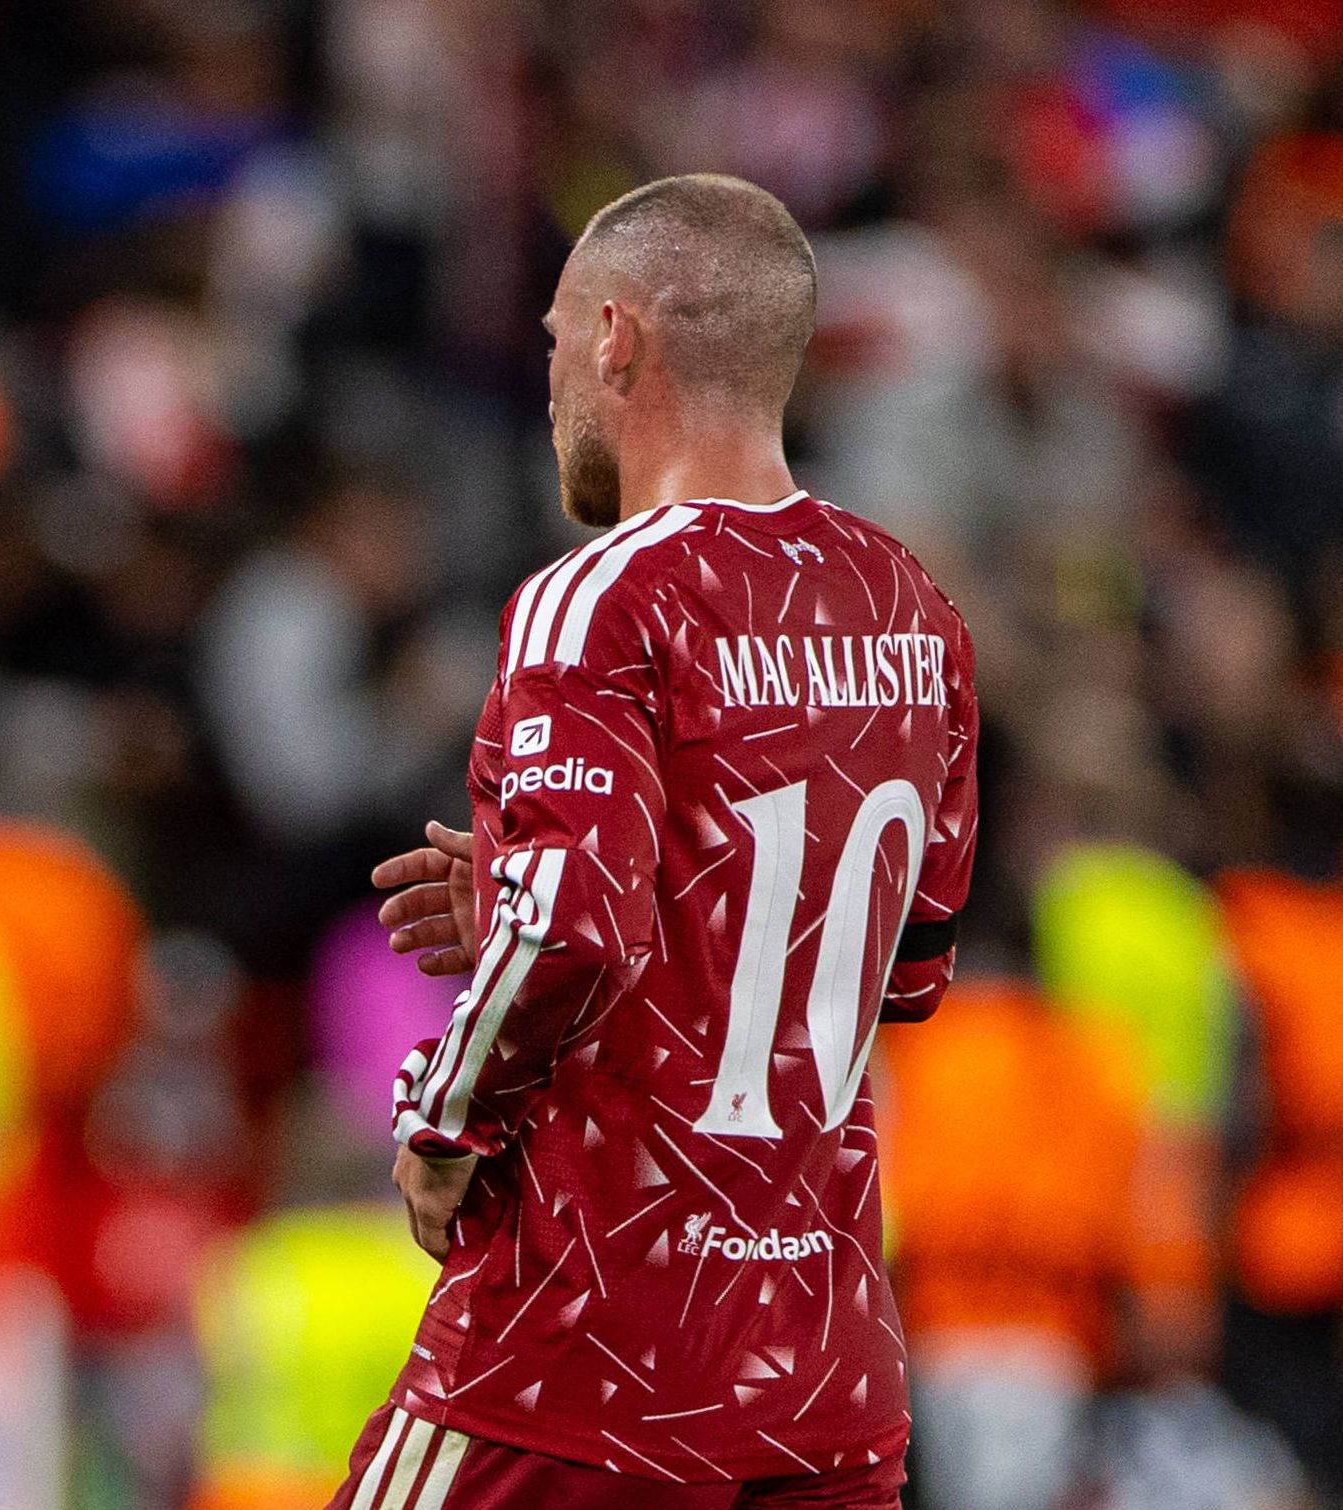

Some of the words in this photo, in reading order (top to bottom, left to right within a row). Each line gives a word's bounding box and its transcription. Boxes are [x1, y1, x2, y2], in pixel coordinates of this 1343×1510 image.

[714, 634, 800, 708] MAC
[802, 633, 947, 707] ALLISTER
[500, 756, 614, 811] pedia
[692, 778, 926, 1140] 10
